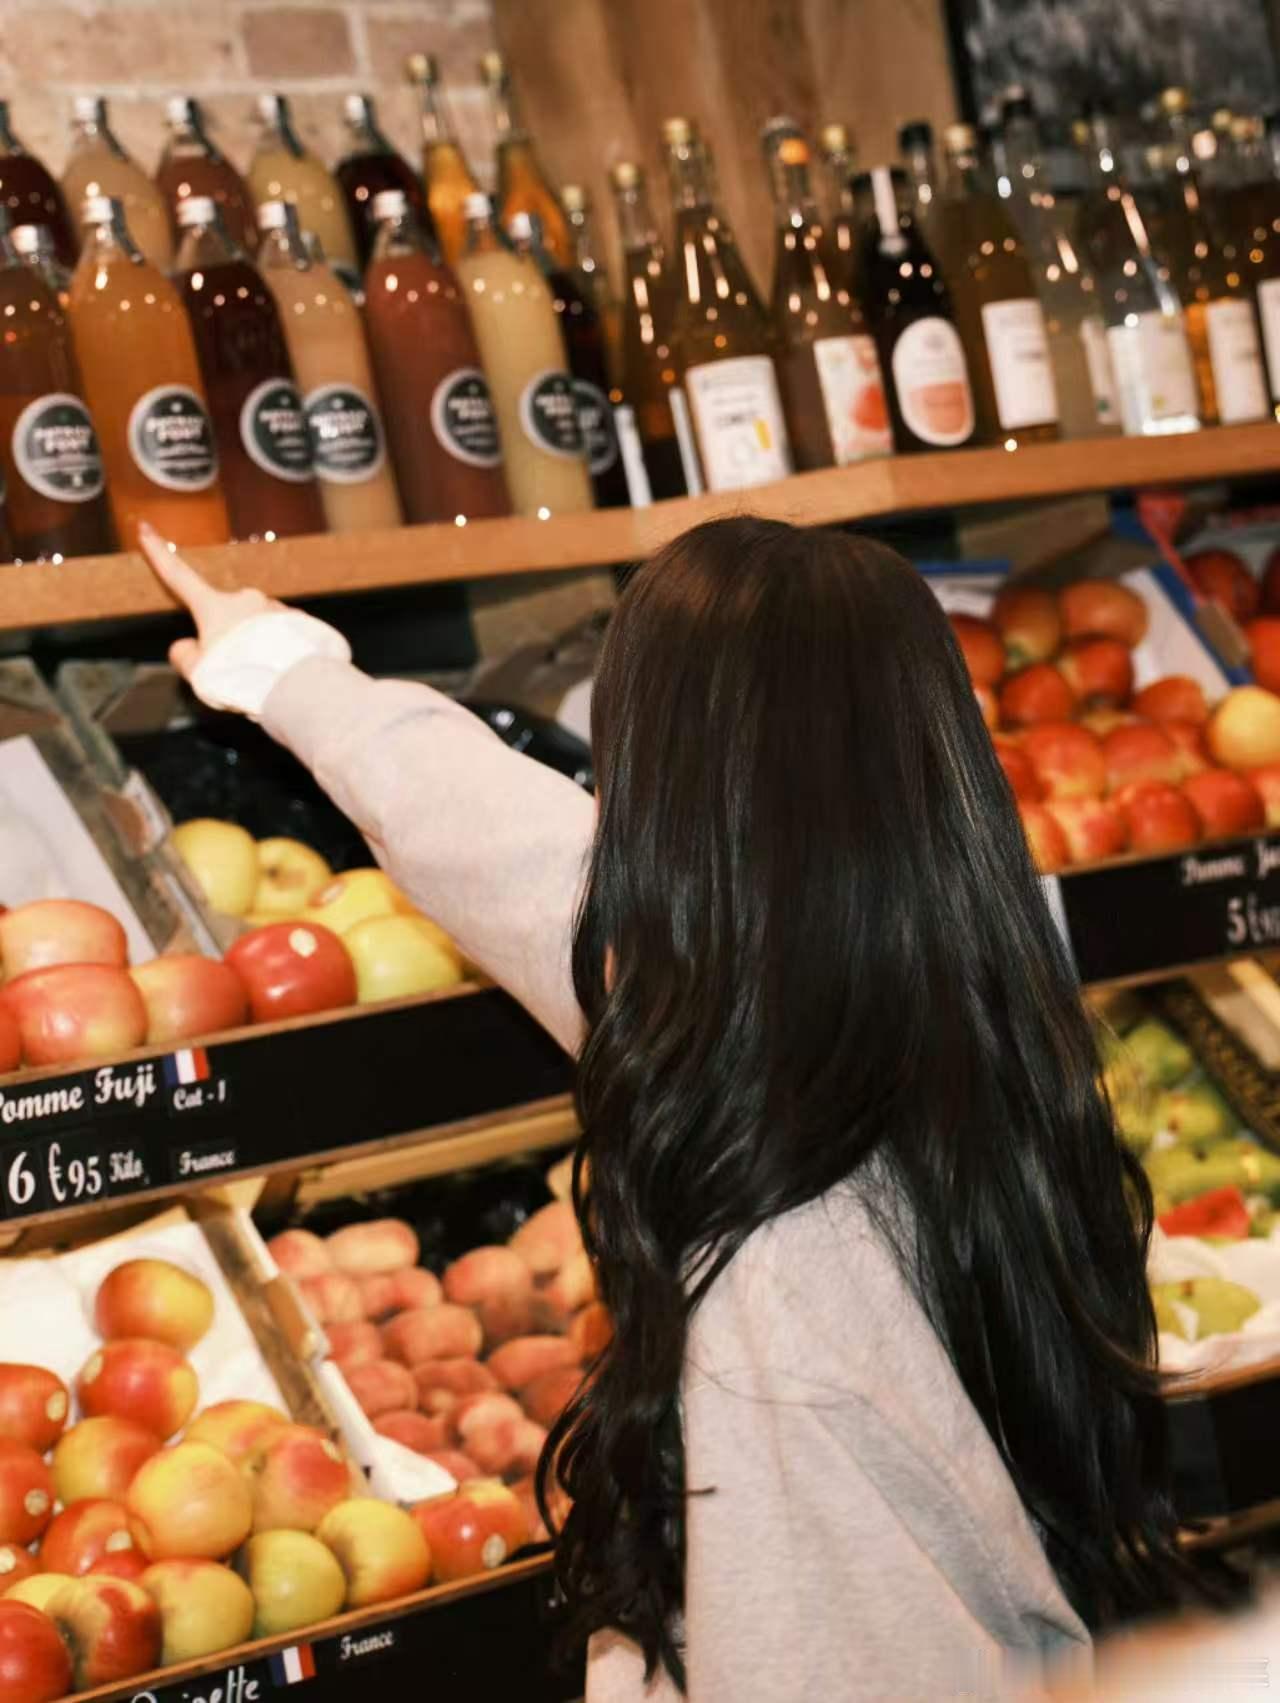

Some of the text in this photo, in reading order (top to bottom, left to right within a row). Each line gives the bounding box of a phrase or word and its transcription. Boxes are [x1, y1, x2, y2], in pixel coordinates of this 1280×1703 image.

[0, 1063, 157, 1124] omme Fuji
[178, 1150, 236, 1175] France
[339, 1629, 395, 1661] France
